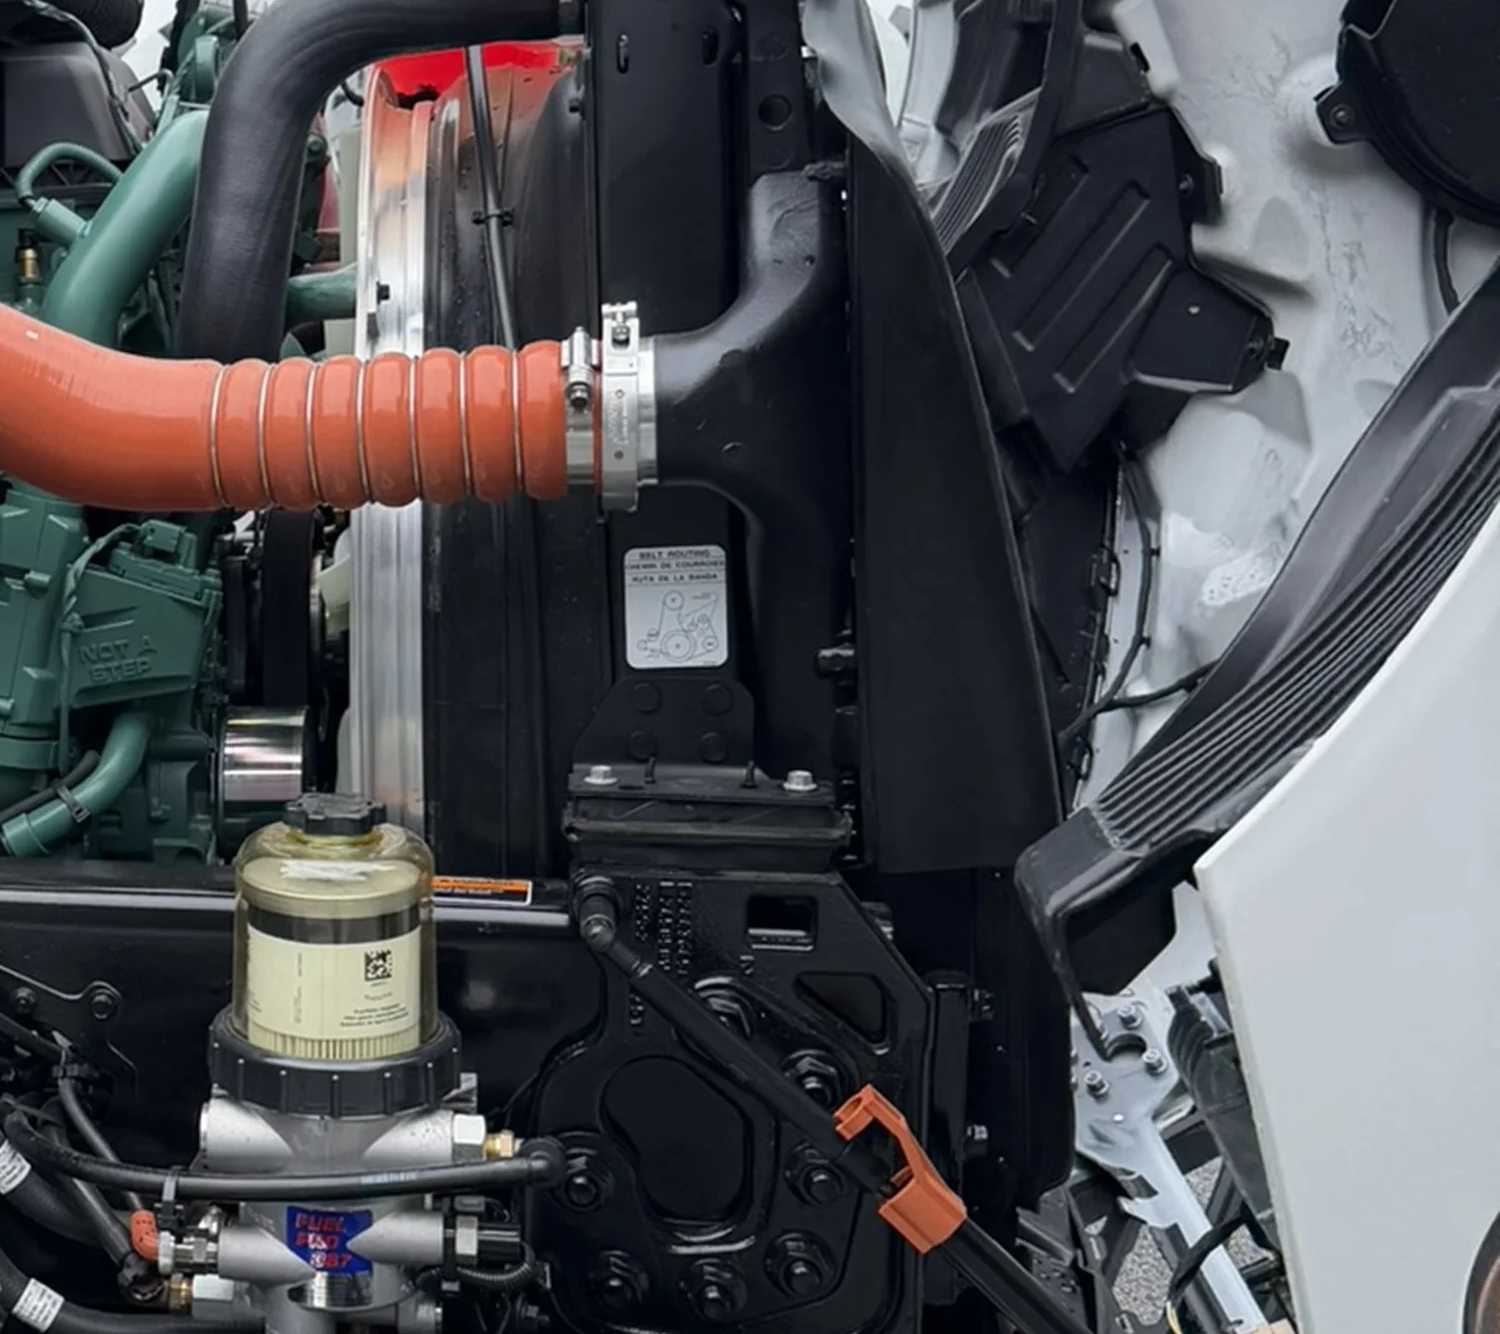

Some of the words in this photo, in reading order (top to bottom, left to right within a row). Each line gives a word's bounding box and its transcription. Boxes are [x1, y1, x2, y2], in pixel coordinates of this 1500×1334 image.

[639, 551, 663, 560] BELT
[667, 549, 710, 560] ROUTING
[673, 574, 684, 582] LA
[78, 639, 130, 664] NOT
[137, 635, 157, 655] A
[91, 657, 153, 683] STEP
[295, 1212, 347, 1234] FUEL
